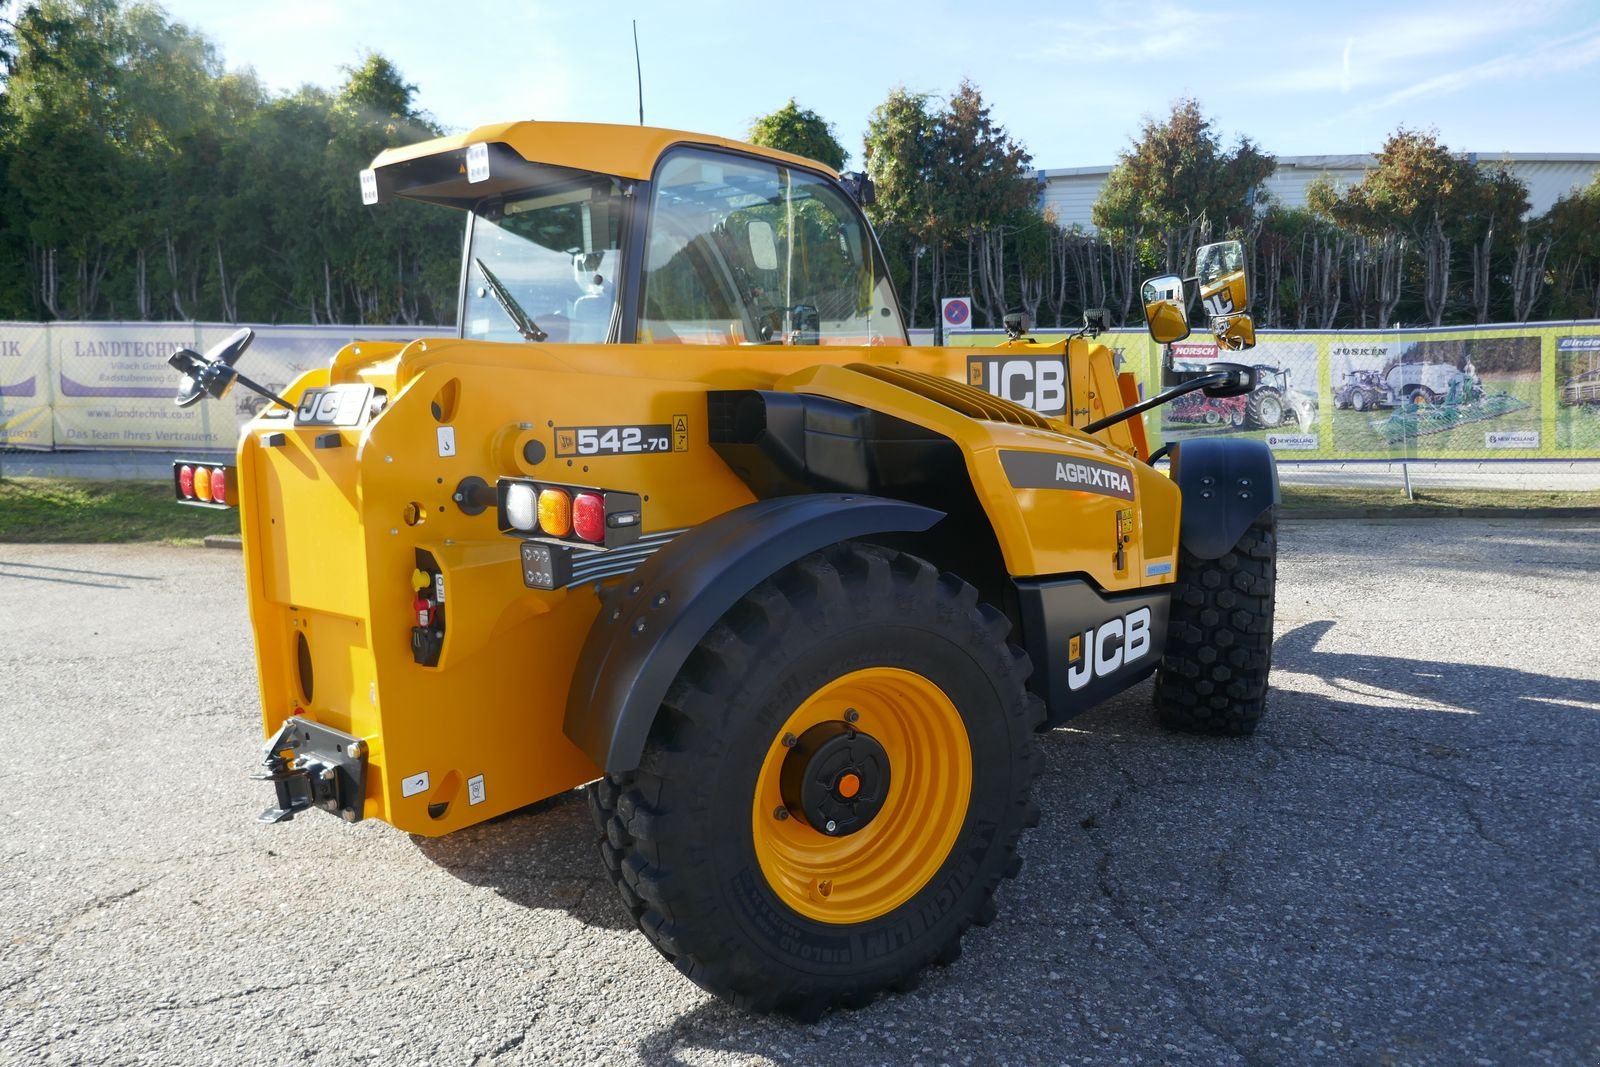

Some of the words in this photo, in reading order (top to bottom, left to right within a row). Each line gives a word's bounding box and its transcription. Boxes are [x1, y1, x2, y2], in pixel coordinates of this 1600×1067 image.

[1175, 347, 1215, 356] HORSCH
[989, 360, 1065, 412] JCB
[298, 392, 362, 422] JC
[67, 429, 88, 439] Das
[91, 429, 120, 440] Team
[124, 430, 151, 440] Ihres
[155, 431, 217, 442] Vertrauens
[578, 427, 669, 455] 542-70
[1056, 462, 1131, 493] AGRIXTRA
[1068, 607, 1151, 690] JCB
